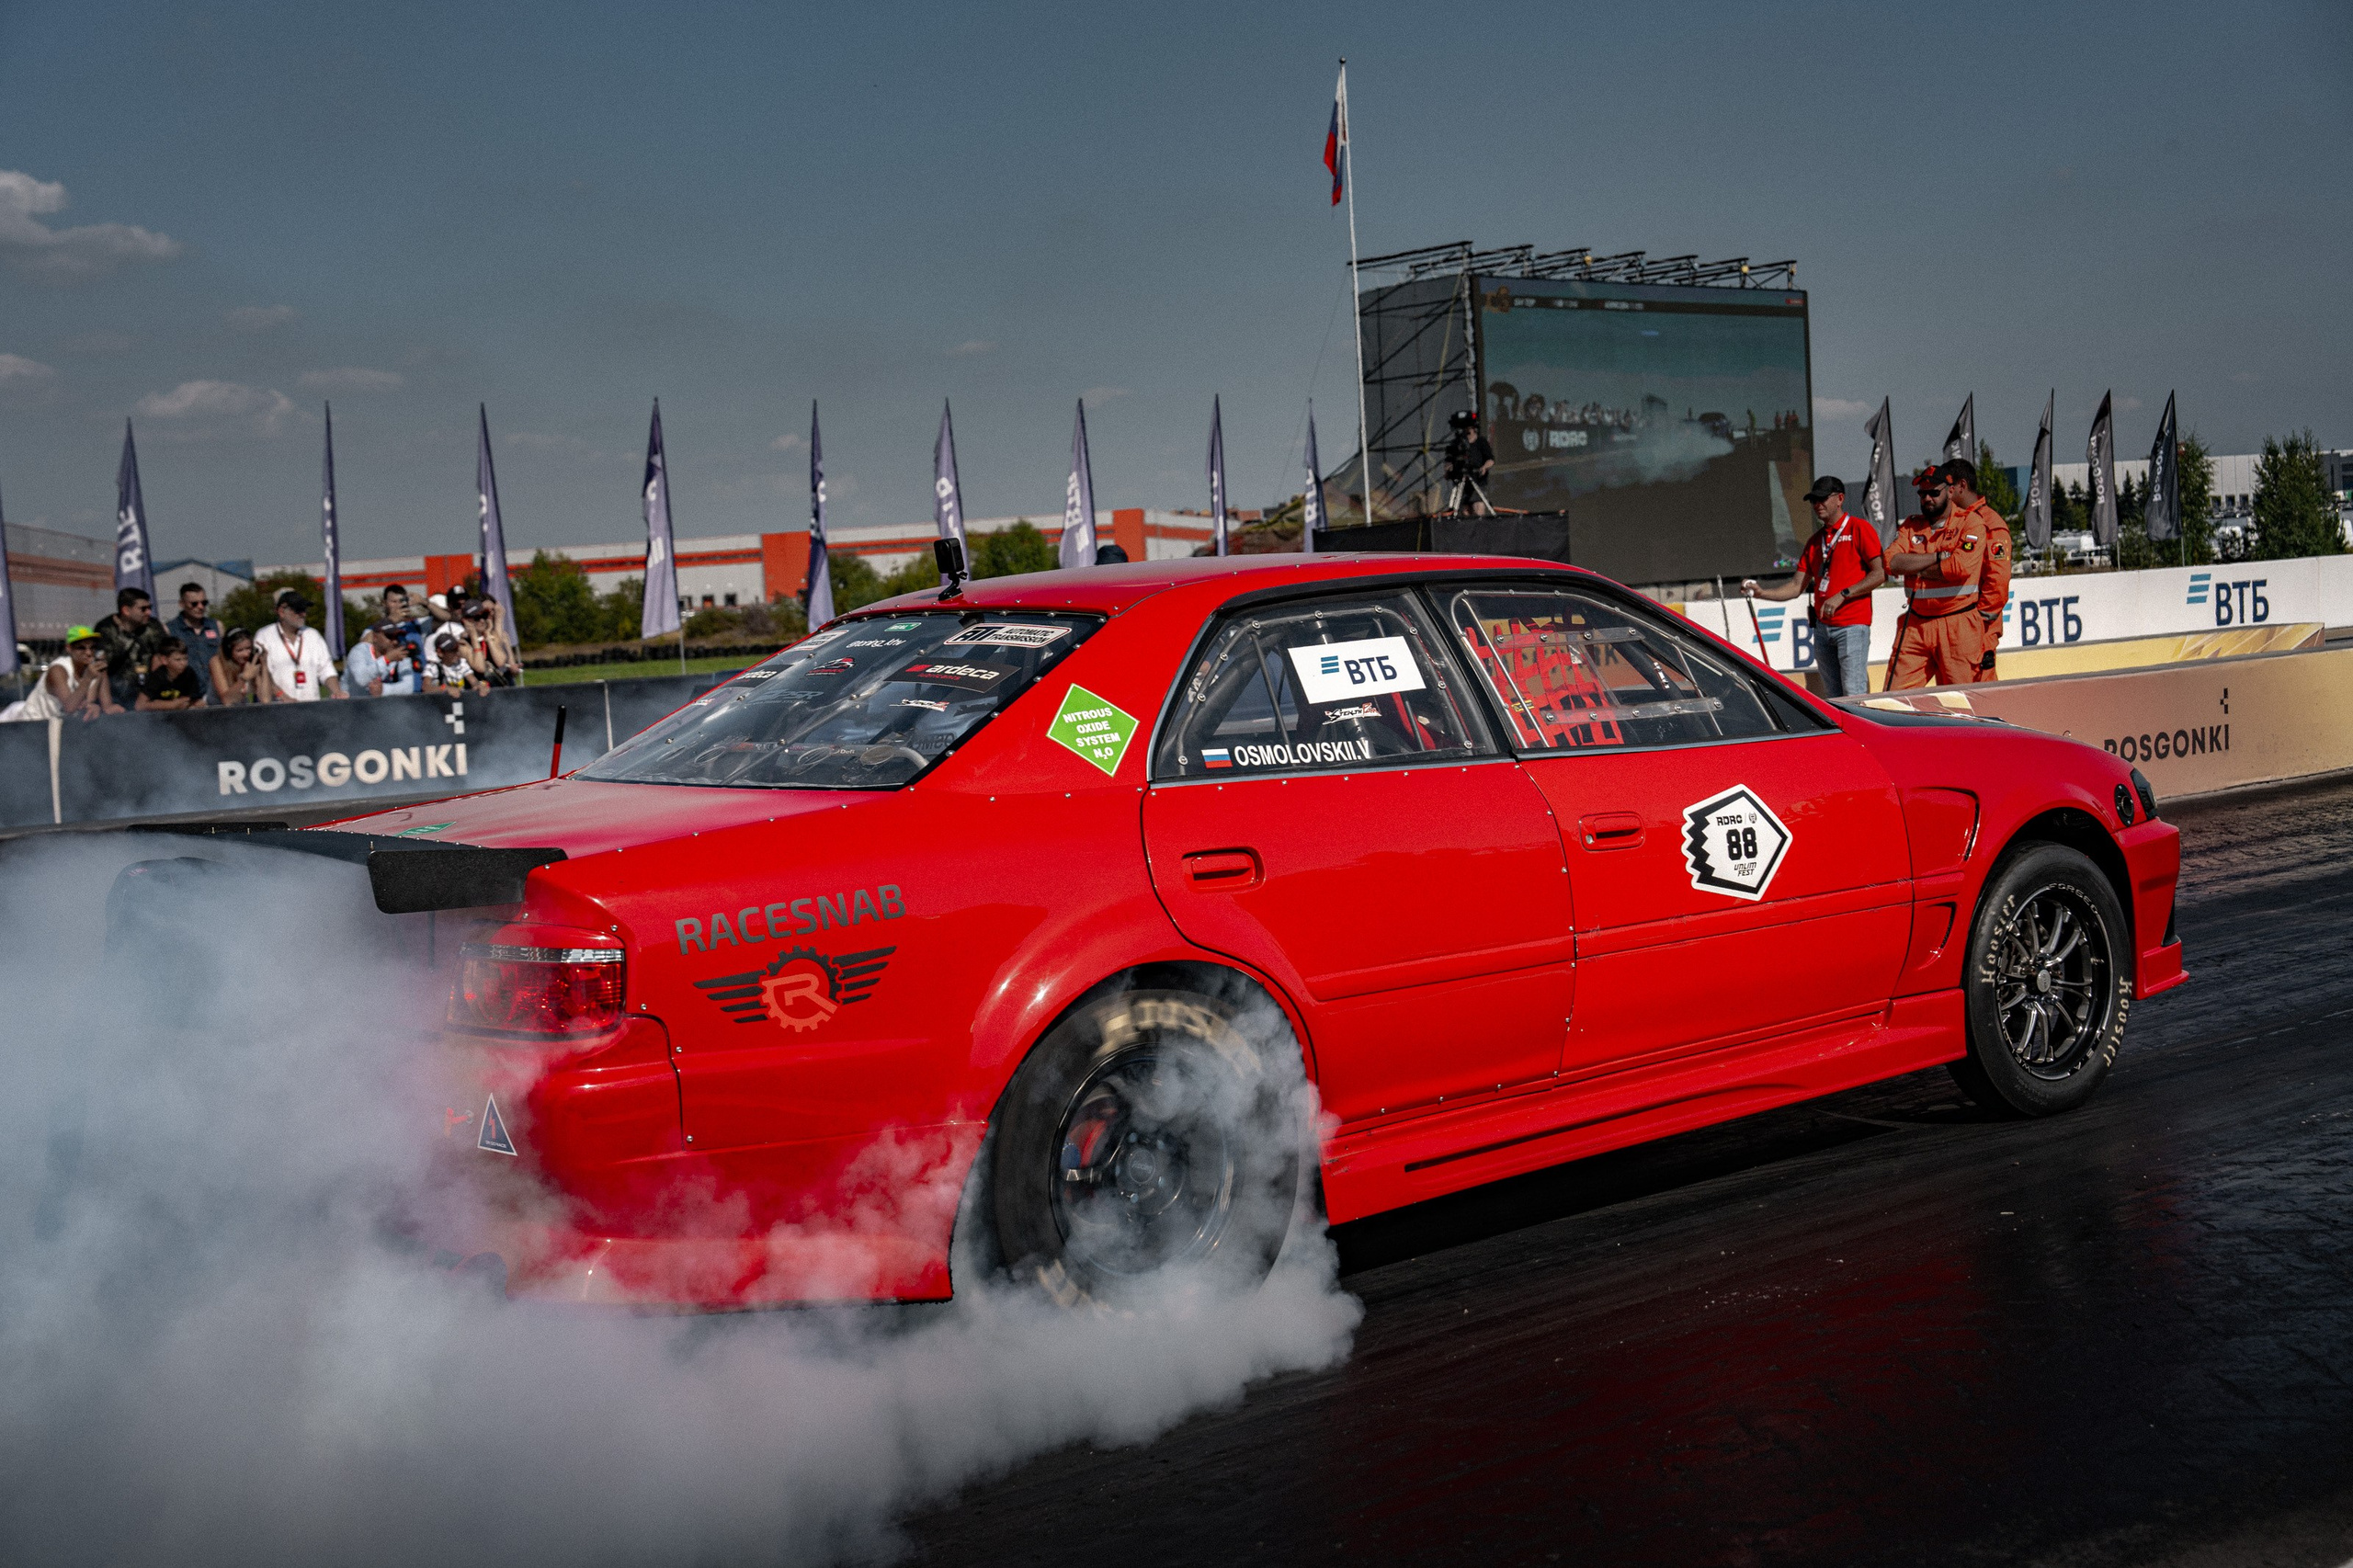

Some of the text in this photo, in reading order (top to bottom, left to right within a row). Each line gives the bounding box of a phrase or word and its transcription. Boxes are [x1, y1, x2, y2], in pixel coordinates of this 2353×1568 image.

[2215, 579, 2269, 627] ВТБ
[1004, 628, 1054, 637] AUTOMATIC
[2020, 596, 2083, 646] ВТБ
[987, 633, 1051, 643] TRANSMISSION
[926, 665, 1000, 680] ardeca
[1344, 655, 1398, 685] ВТБ
[1063, 708, 1113, 723] NITROUS
[1076, 721, 1111, 733] OXIDE
[1075, 733, 1120, 747] SYSTEM
[1233, 740, 1370, 767] OSMOLOVSKII.V
[217, 743, 469, 796] ROSGONKI
[1716, 814, 1744, 826] RDRC
[1726, 827, 1758, 860] 88
[2048, 882, 2098, 915] FORGED
[675, 883, 906, 956] RACESNAB
